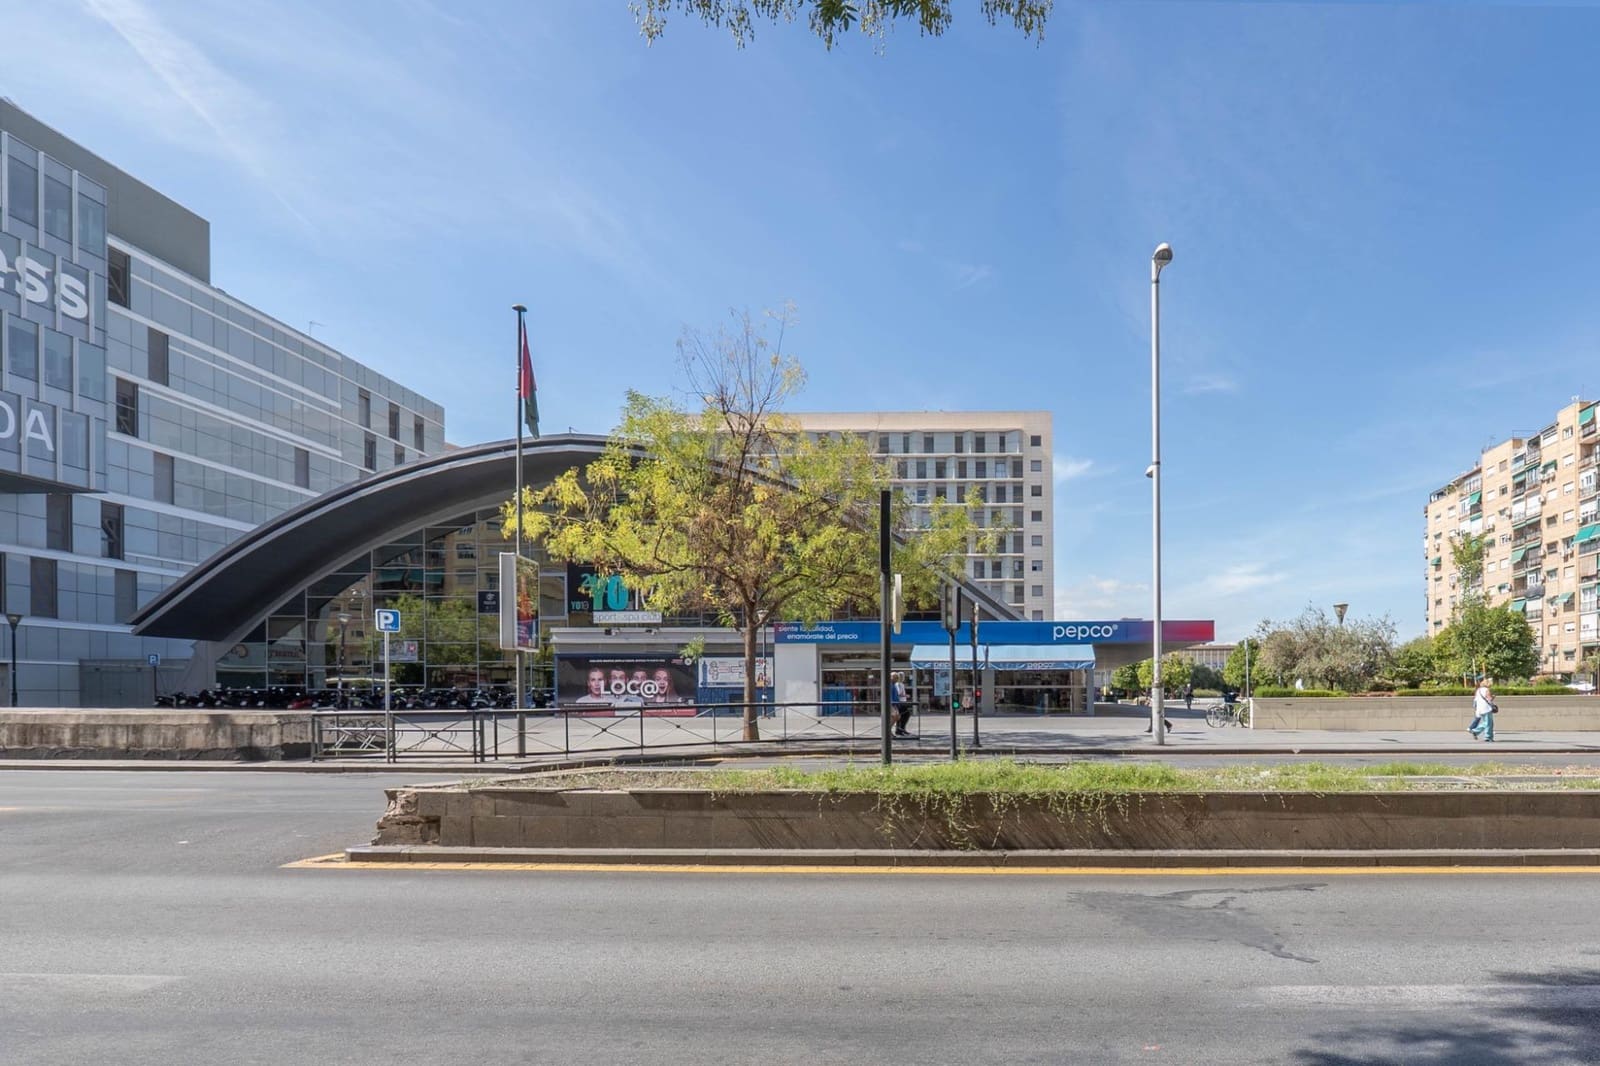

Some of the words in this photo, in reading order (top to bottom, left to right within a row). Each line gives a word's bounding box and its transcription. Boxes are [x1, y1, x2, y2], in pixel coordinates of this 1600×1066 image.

[0, 248, 88, 319] ss
[380, 612, 394, 629] P
[825, 632, 836, 640] del
[837, 633, 858, 641] precio
[1053, 625, 1113, 641] pepco
[600, 680, 658, 698] LOC@
